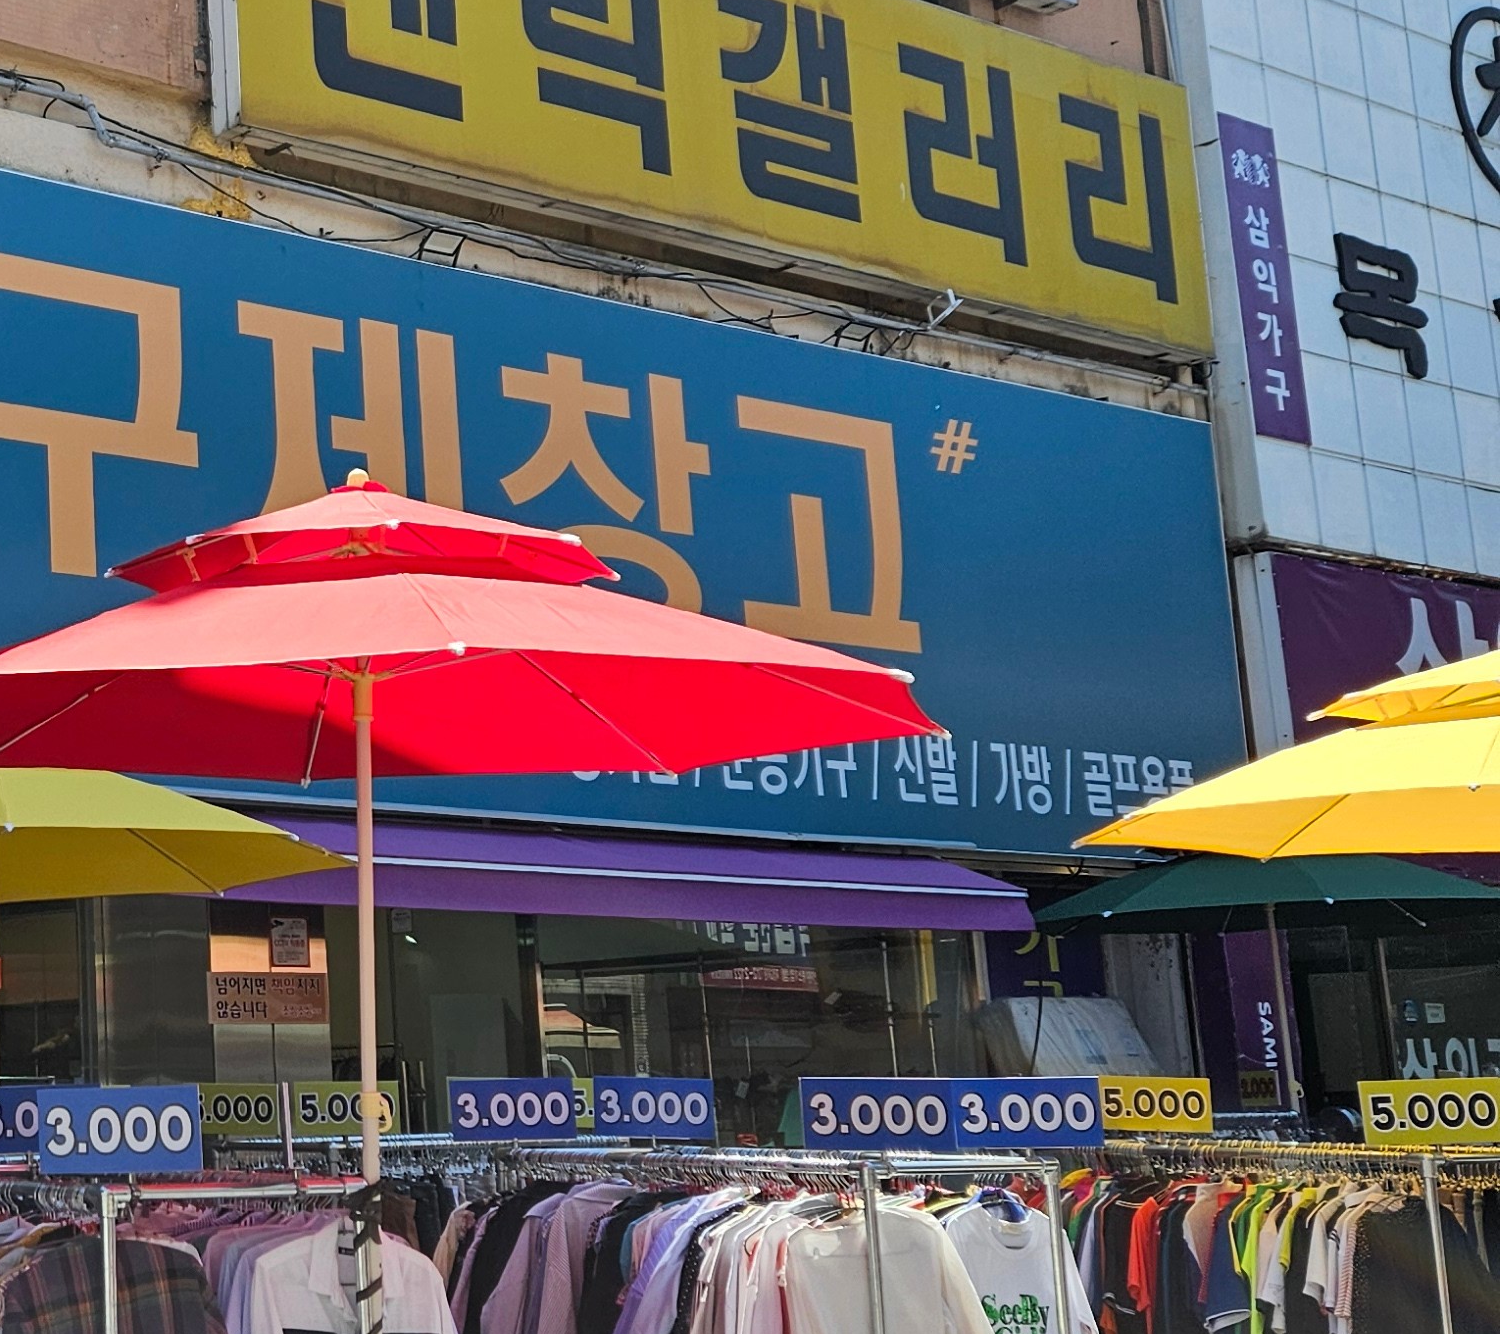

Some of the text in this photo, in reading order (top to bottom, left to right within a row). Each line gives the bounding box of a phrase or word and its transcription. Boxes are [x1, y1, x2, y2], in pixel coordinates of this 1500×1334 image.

[1243, 205, 1291, 413] 삼익가구
[1333, 232, 1429, 379] 목
[894, 735, 959, 805] 신발
[990, 742, 1053, 815] 가방
[216, 977, 320, 996] 넘어지면 책임지지
[216, 1000, 267, 1018] 않습니다
[199, 1094, 276, 1123] .000
[455, 1091, 571, 1129] 3.000
[599, 1088, 709, 1125] 3.000
[809, 1092, 948, 1136] 3.000
[959, 1091, 1096, 1134] 3.000
[1102, 1087, 1206, 1120] 5.000
[1368, 1091, 1499, 1132] 5.000
[45, 1104, 193, 1157] 3.000
